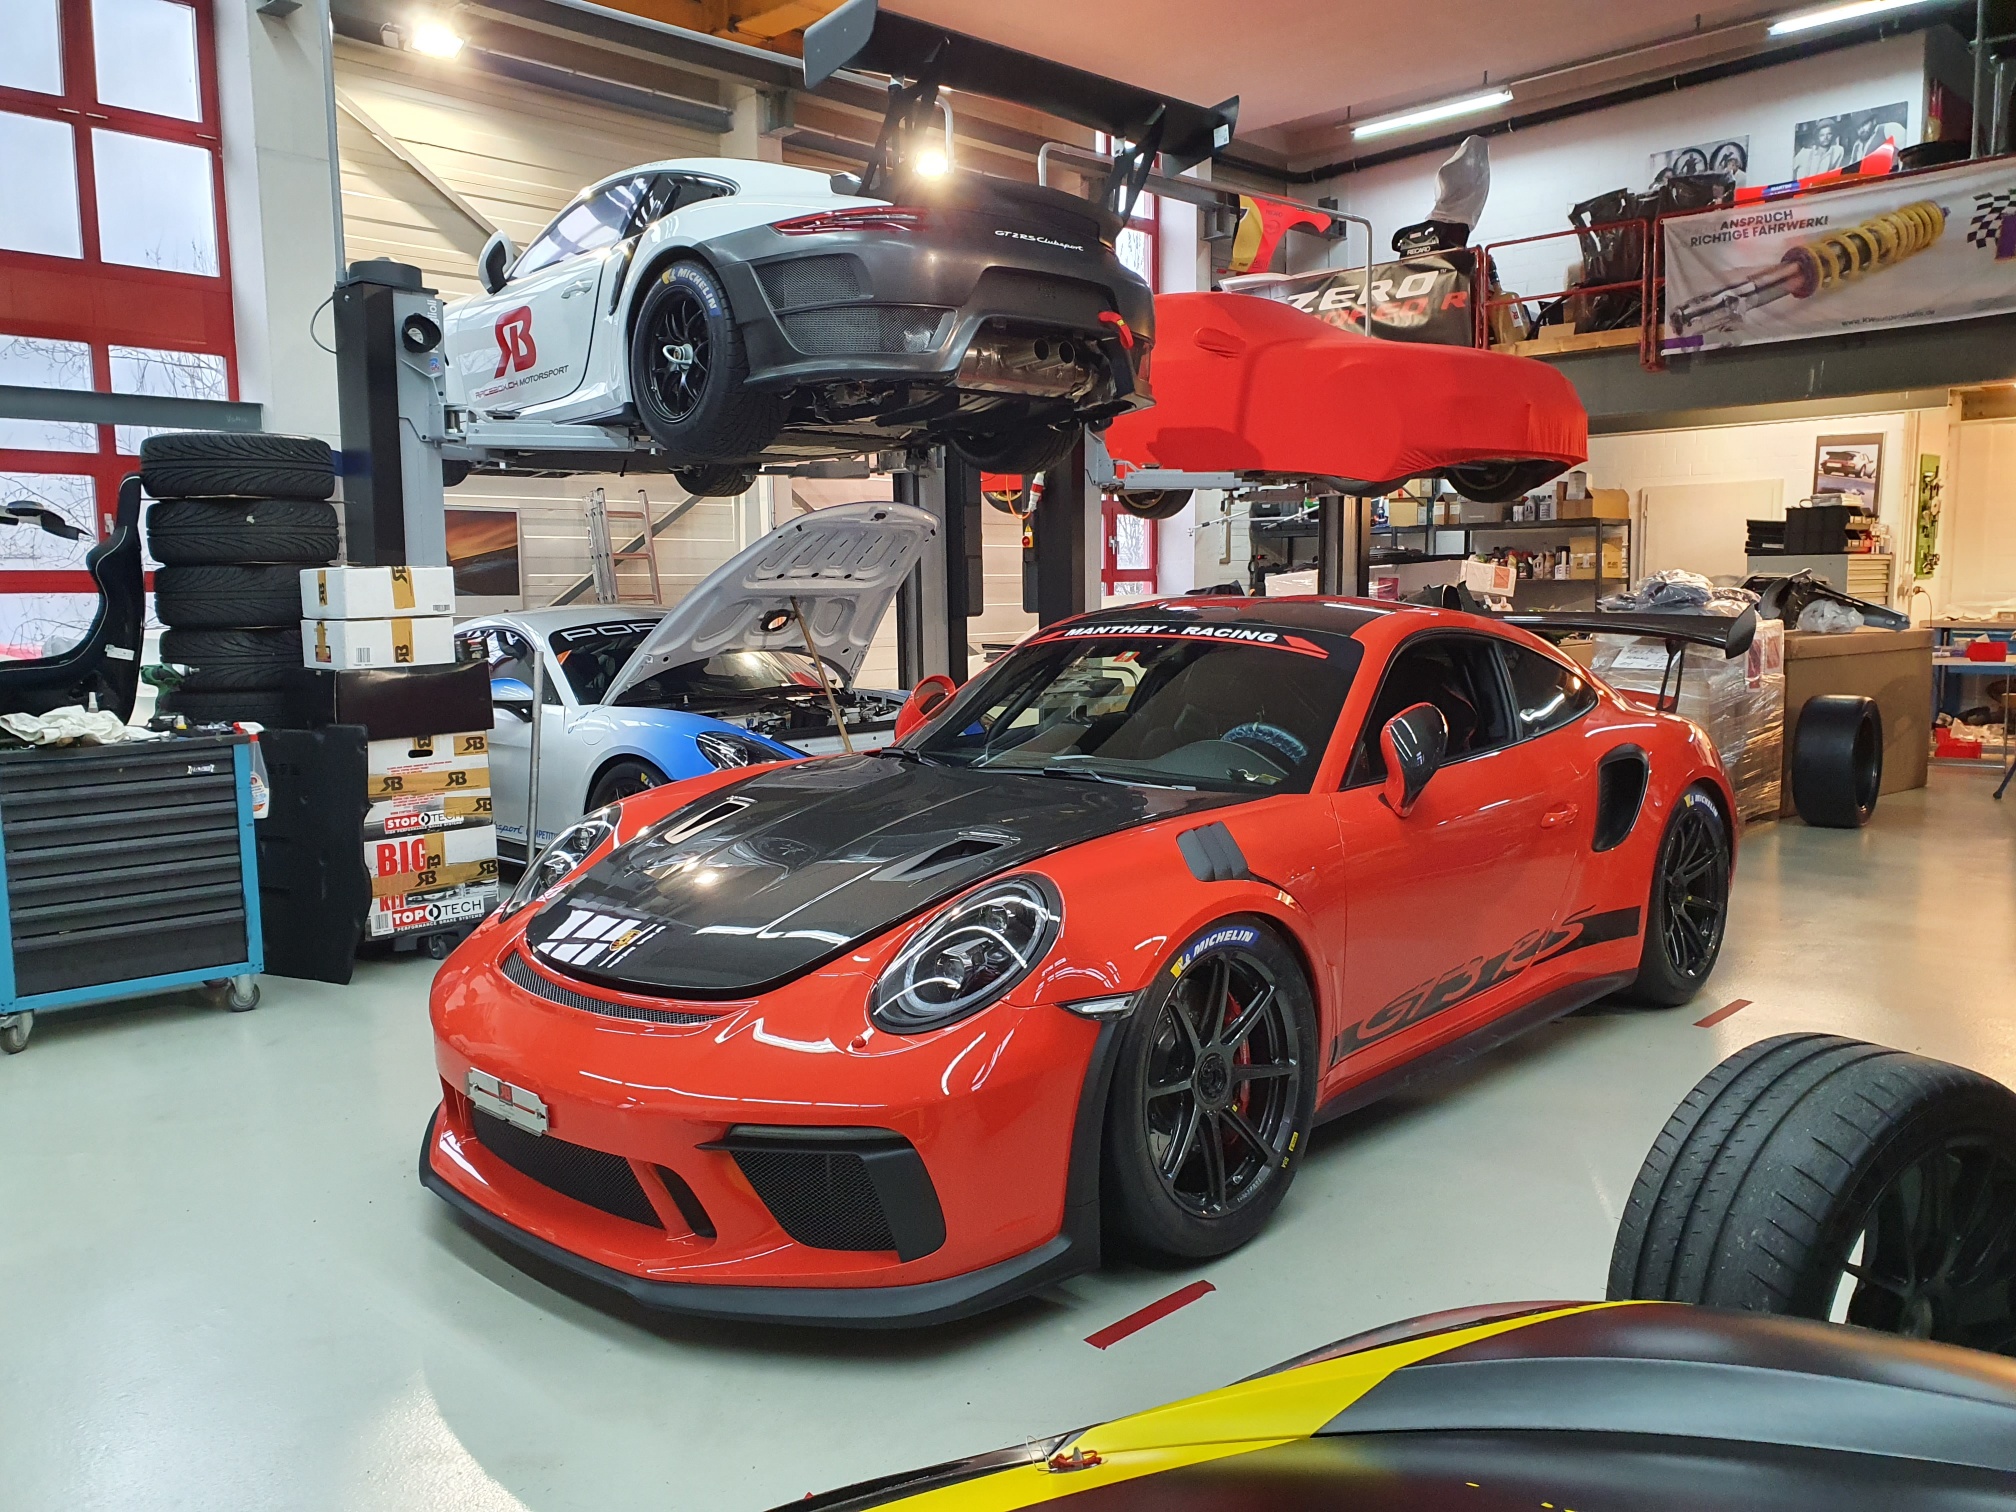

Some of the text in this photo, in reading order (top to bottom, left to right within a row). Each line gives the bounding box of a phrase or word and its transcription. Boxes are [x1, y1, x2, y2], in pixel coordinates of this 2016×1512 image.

[1720, 209, 1794, 231] ANSPRUCH
[1690, 227, 1750, 248] RICHTIGE
[1407, 245, 1431, 256] RECARO
[677, 267, 718, 310] MICHELIN
[1286, 270, 1439, 314] ZERO
[1440, 291, 1468, 311] R
[519, 364, 570, 388] MOTORSPORT
[1064, 625, 1168, 637] MANTHEY
[1180, 625, 1279, 643] RACING
[376, 838, 426, 877] BIG
[393, 908, 424, 926] TOP
[1193, 929, 1254, 958] MICHELIN
[1357, 955, 1484, 1040] GT3
